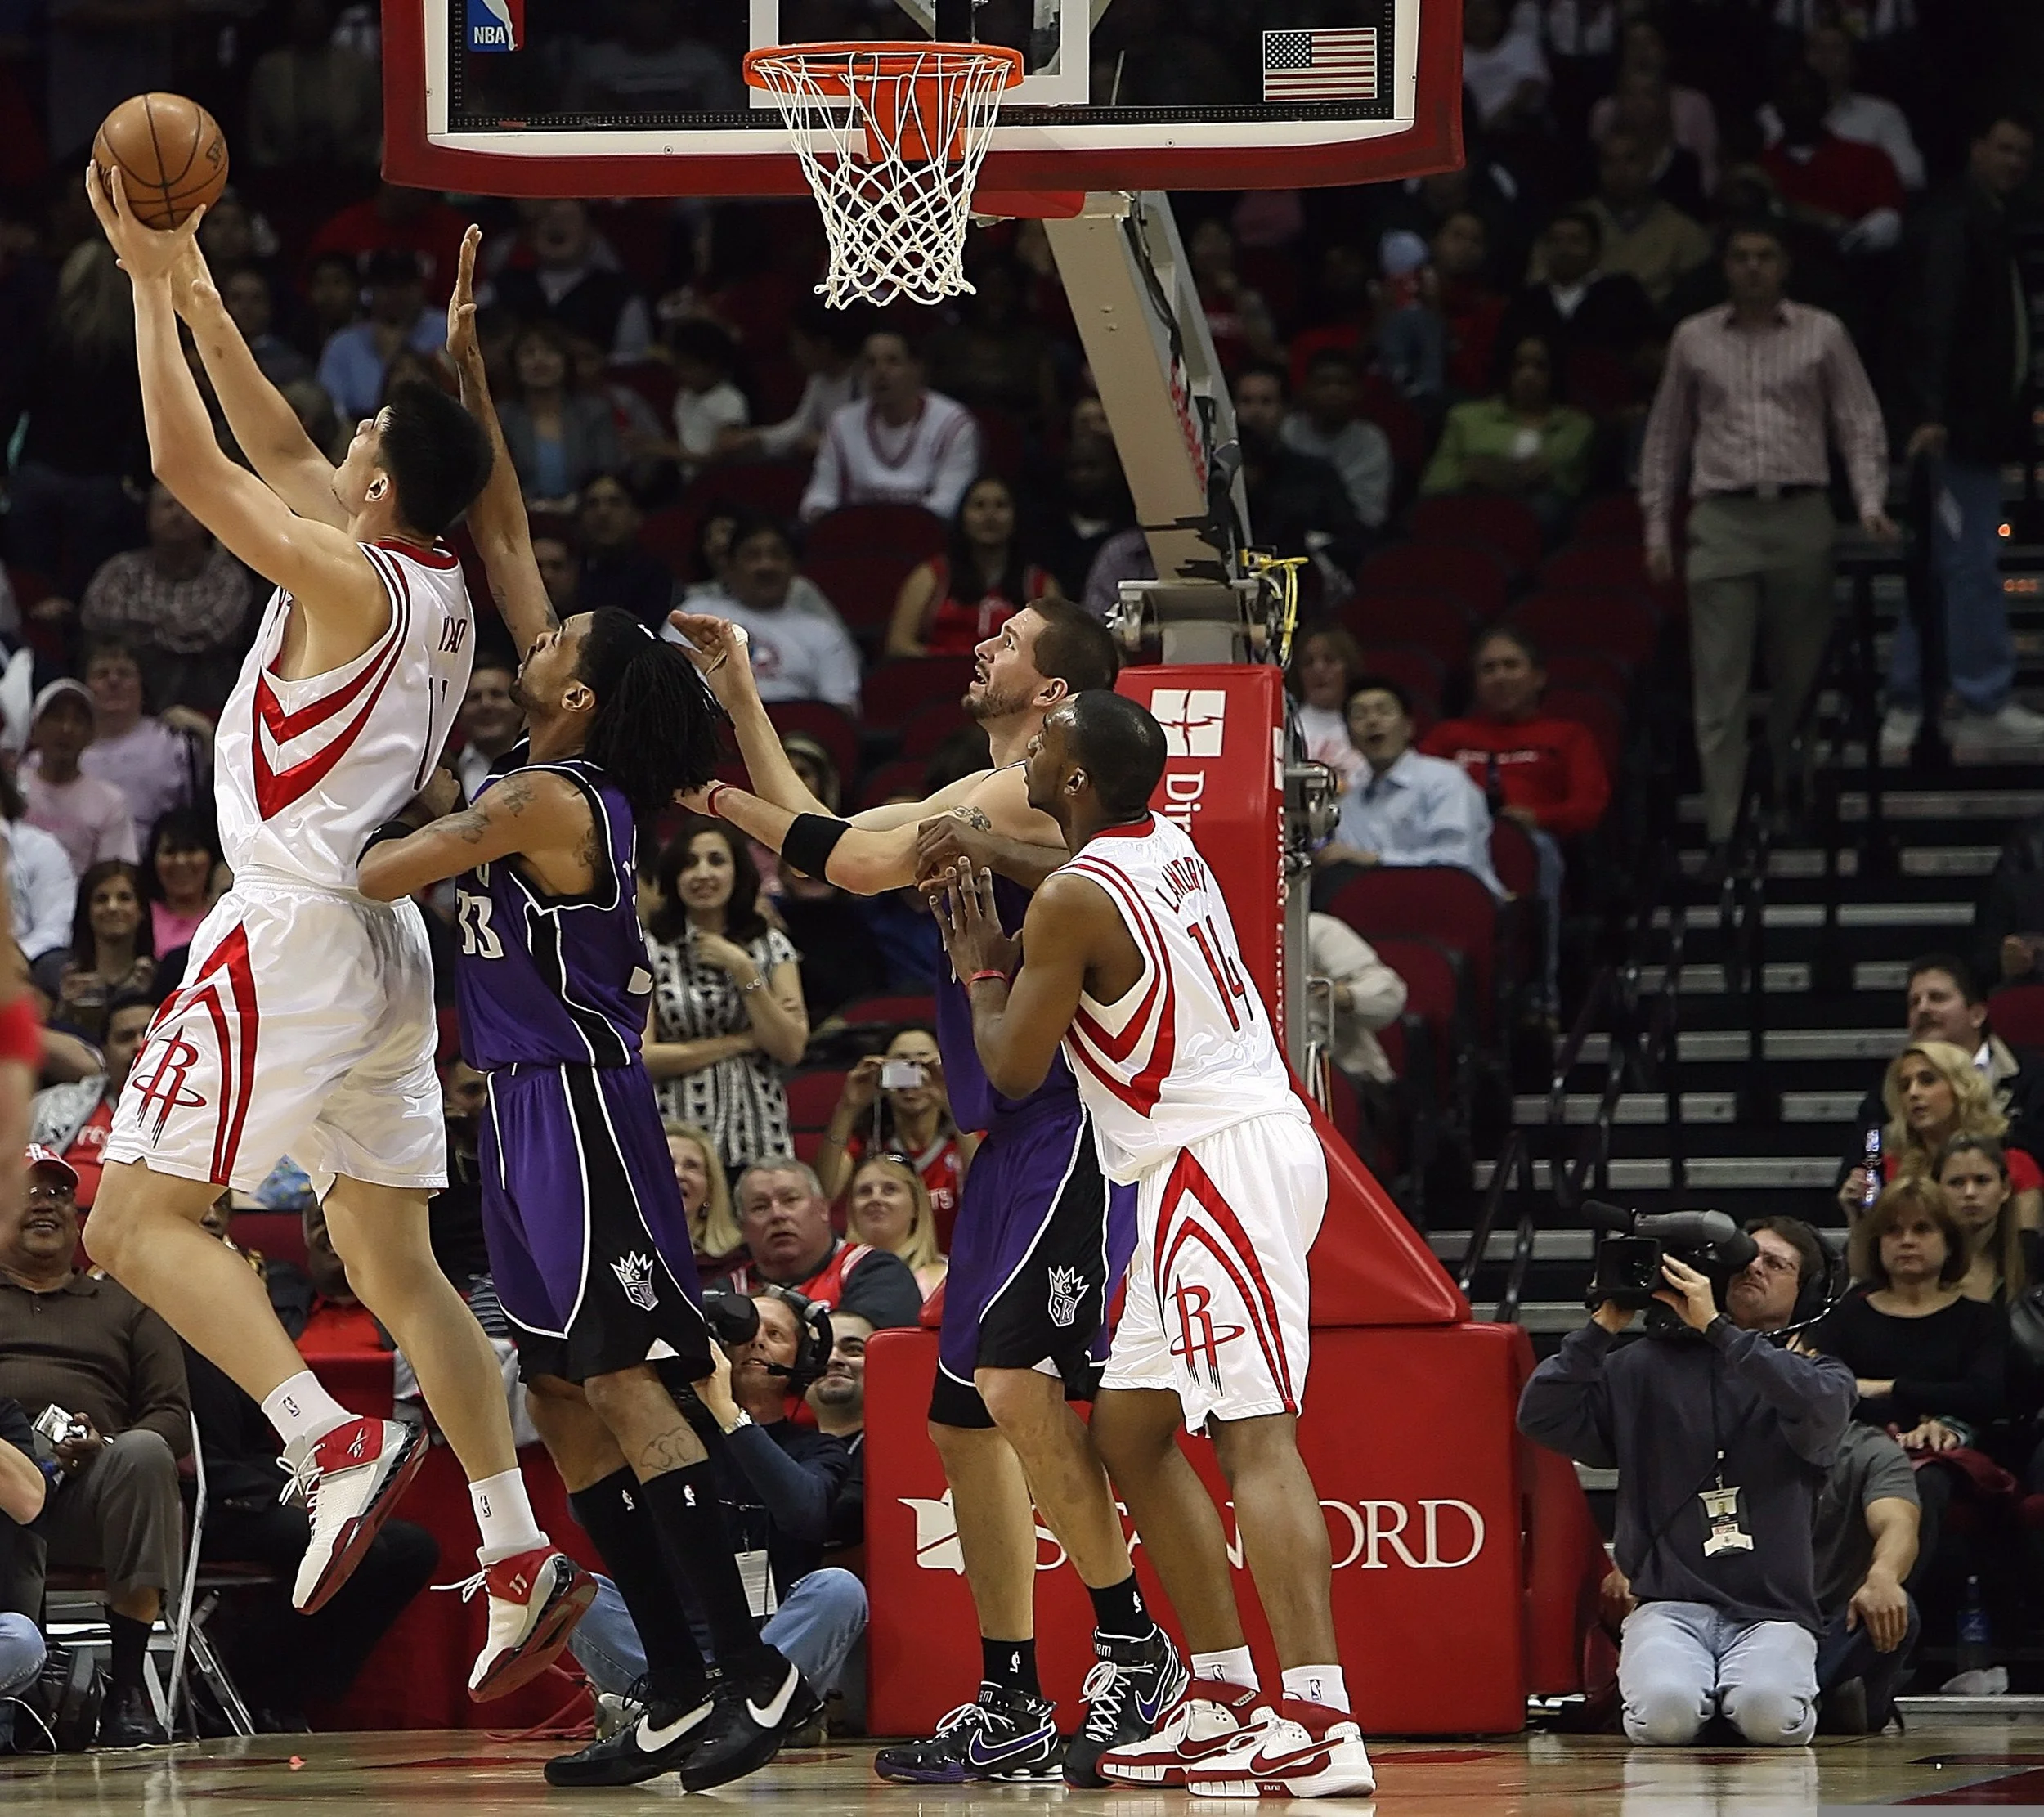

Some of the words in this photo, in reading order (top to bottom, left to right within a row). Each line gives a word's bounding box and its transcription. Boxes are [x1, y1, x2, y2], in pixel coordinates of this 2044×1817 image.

[474, 26, 506, 44] NBA
[437, 616, 468, 653] YAO
[1155, 857, 1208, 914] LANDRY
[1186, 914, 1254, 1033] 14
